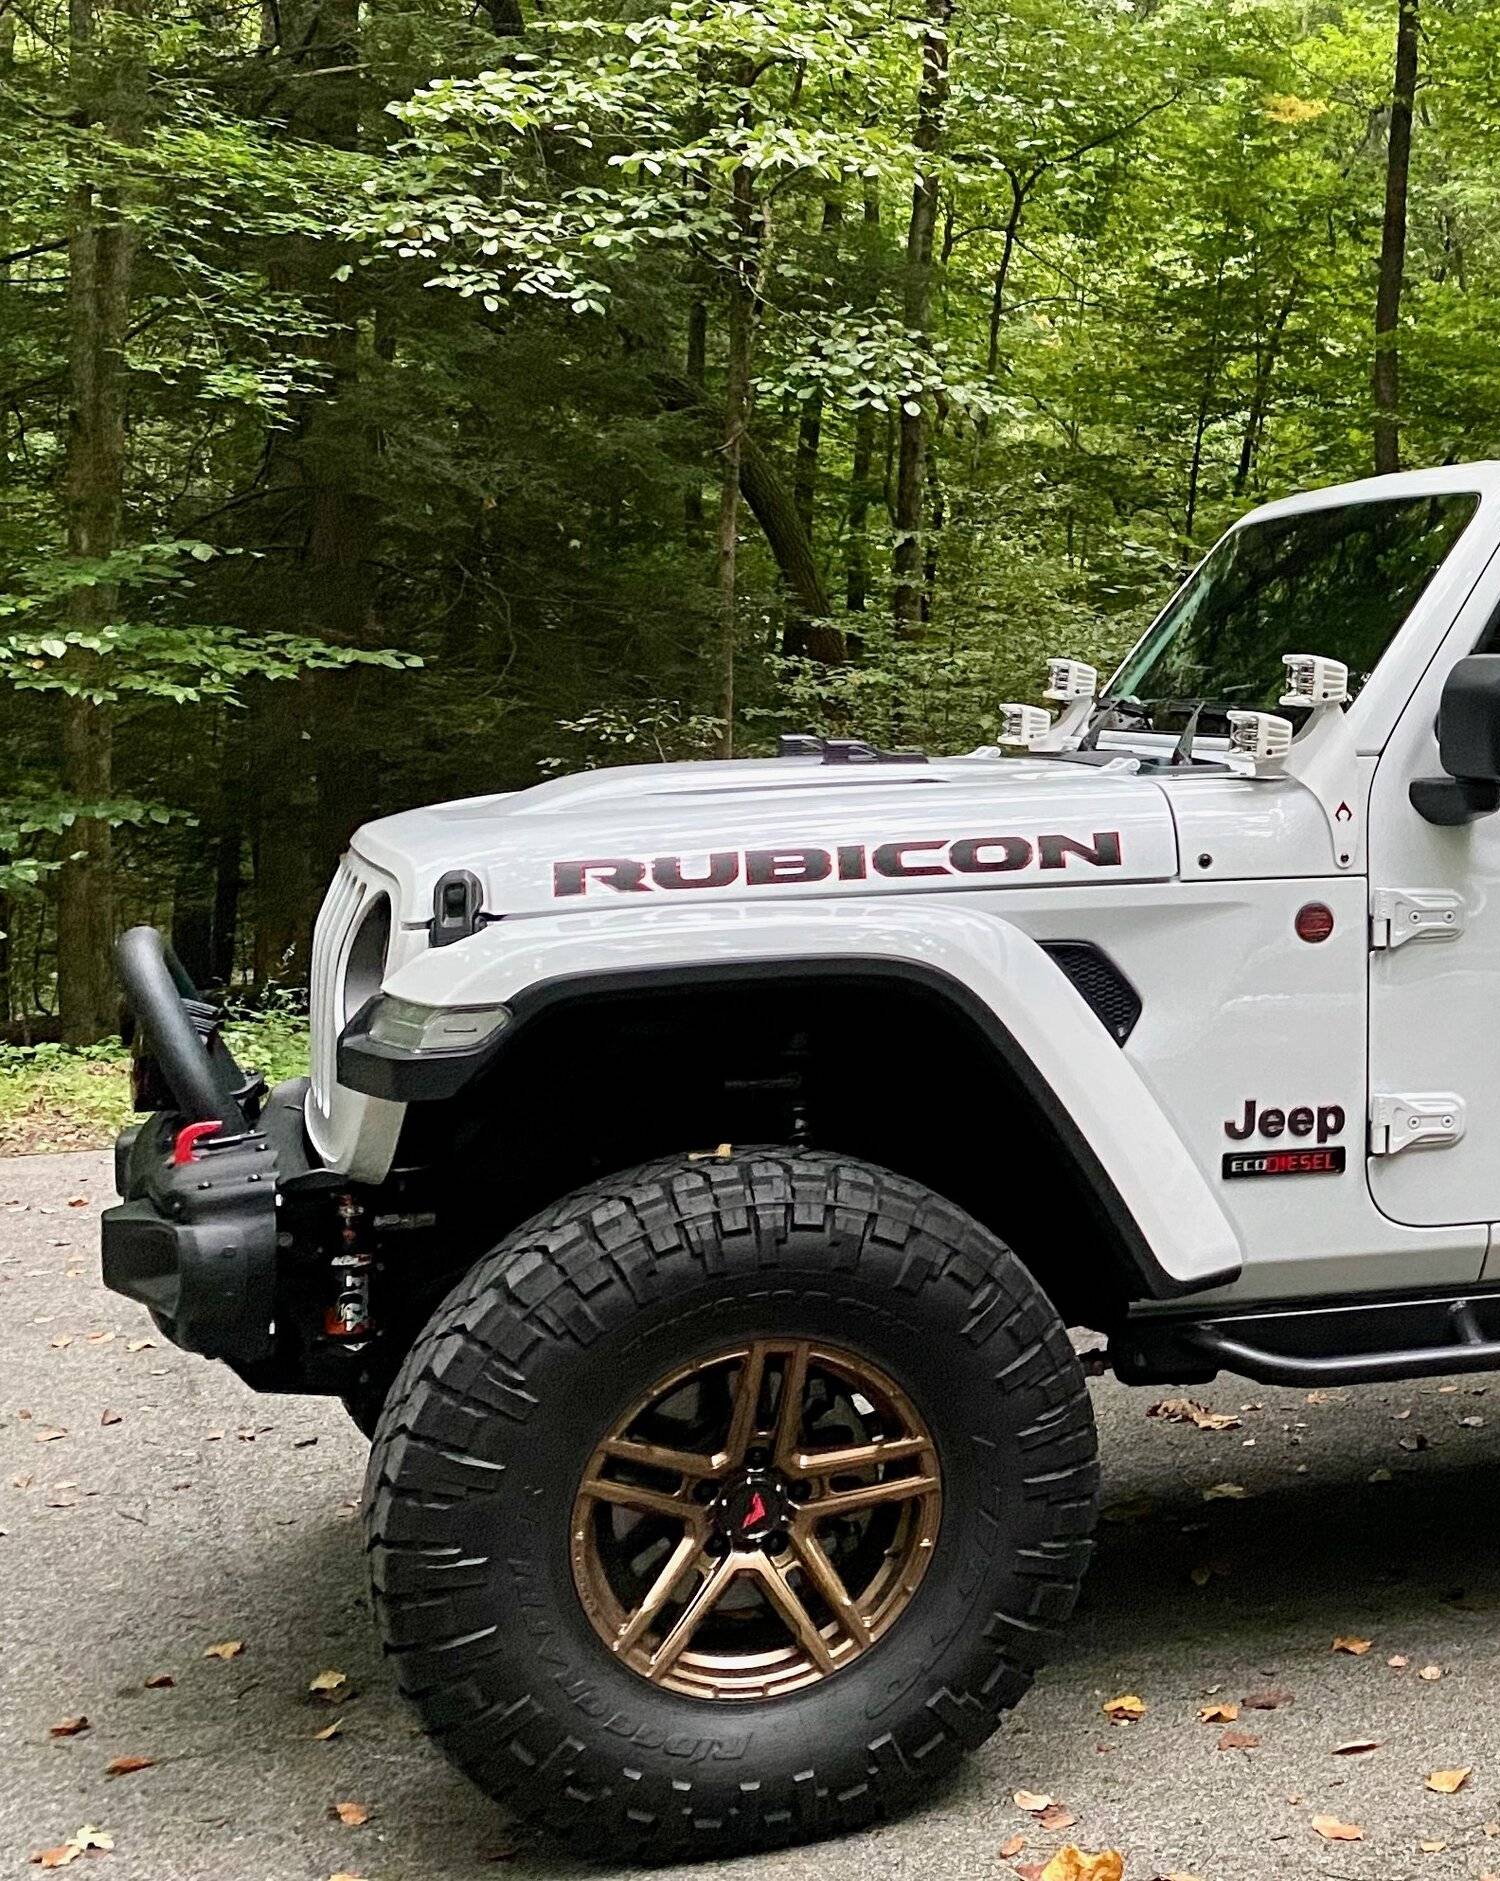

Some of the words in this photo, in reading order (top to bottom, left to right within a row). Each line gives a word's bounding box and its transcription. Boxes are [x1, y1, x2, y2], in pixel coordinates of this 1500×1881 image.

[553, 832, 1121, 896] RUBICON
[1225, 1100, 1345, 1143] Jeep
[1232, 1154, 1335, 1172] ECODIESEL
